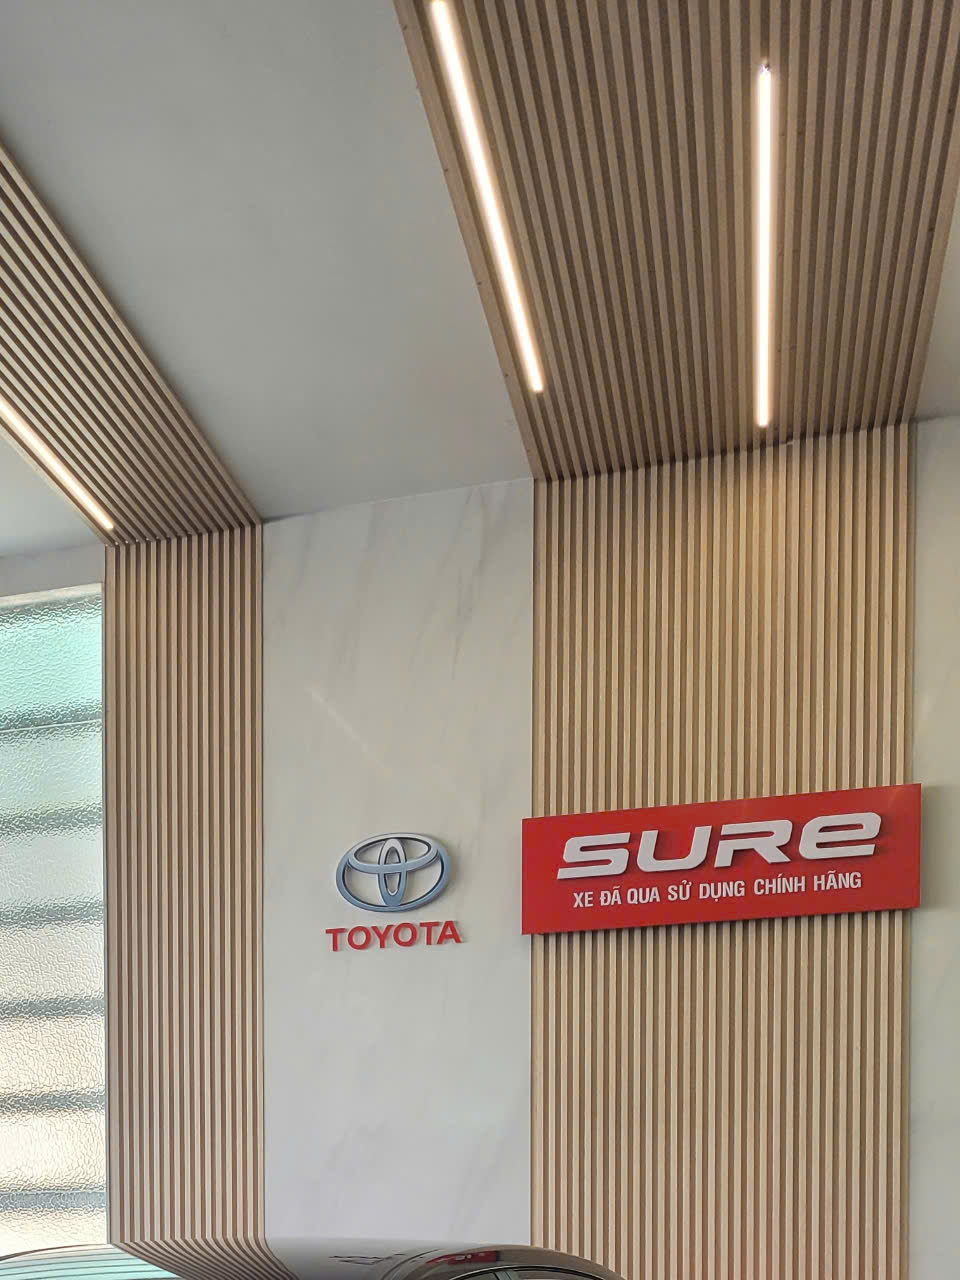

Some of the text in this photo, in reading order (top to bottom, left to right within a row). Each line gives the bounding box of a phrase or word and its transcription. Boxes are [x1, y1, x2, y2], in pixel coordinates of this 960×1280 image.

[573, 870, 862, 908] XE ĐÃ QUA SỬ DỤNG CHÍNH HÃNG
[325, 920, 462, 951] TOYOTA
